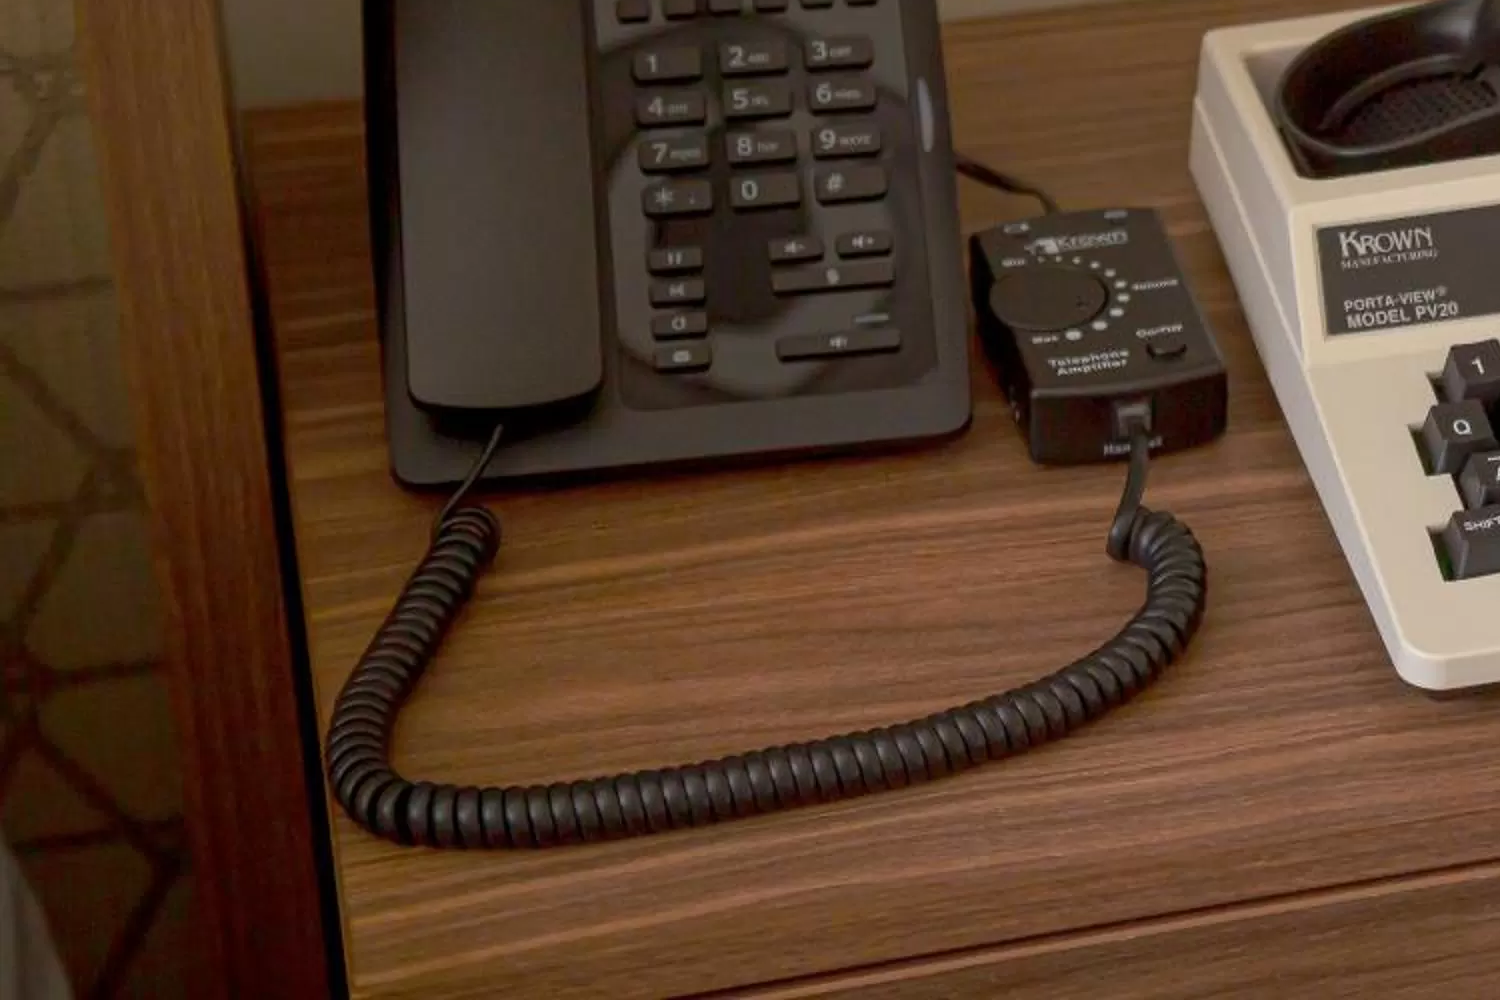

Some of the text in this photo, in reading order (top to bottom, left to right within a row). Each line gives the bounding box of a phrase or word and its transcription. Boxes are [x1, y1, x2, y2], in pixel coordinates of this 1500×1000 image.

[728, 46, 747, 67] 2
[811, 40, 828, 61] 3
[647, 53, 658, 73] 1
[732, 88, 749, 110] 5
[816, 83, 832, 104] 6
[648, 97, 663, 118] 4
[737, 137, 752, 157] 8
[819, 129, 837, 150] 9
[652, 144, 668, 165] 7
[741, 180, 758, 200] 0
[1338, 226, 1434, 259] KROWN
[1340, 249, 1438, 271] MANUFACTURING
[1346, 301, 1459, 329] MODEL PV20
[1048, 350, 1131, 368] Telephone
[1057, 359, 1128, 377] Amplifier
[1472, 358, 1485, 375] 1
[1453, 419, 1472, 436] Q
